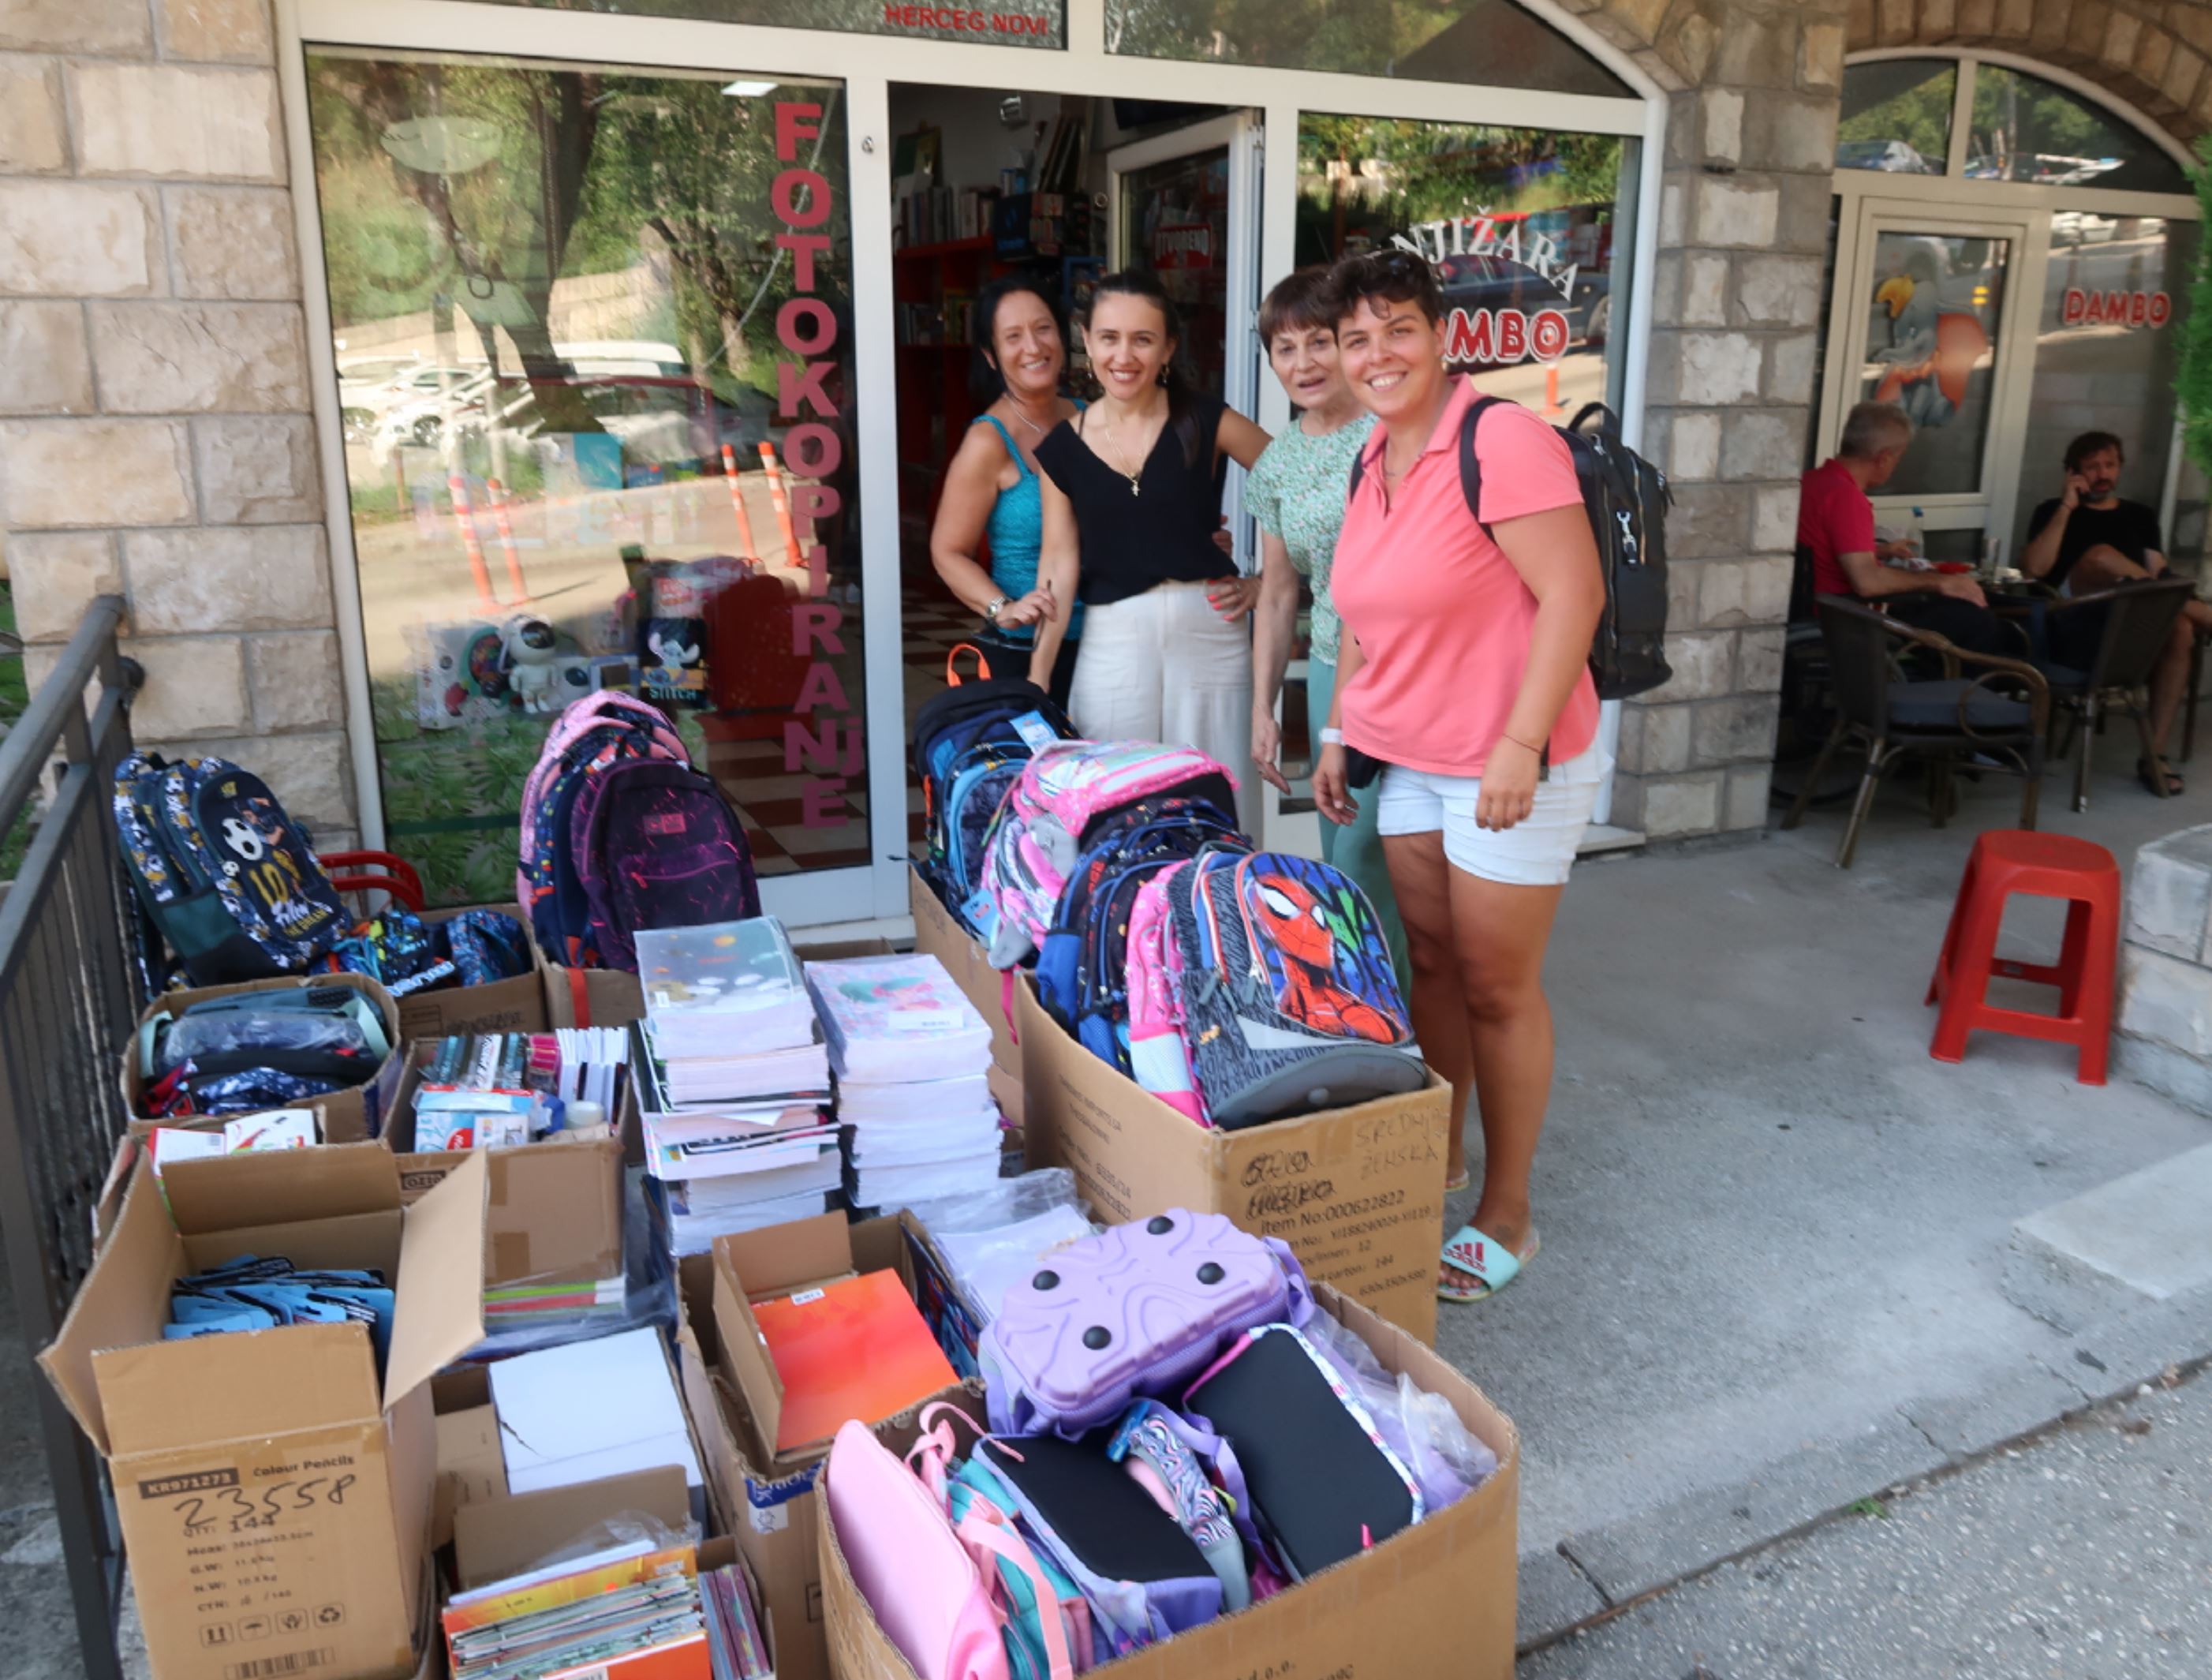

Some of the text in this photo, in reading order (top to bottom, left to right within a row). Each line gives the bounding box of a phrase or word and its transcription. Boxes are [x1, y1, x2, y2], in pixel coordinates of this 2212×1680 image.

[884, 4, 1048, 36] HERCEG NOVI
[1390, 204, 1579, 301] NJIŽARA
[2064, 288, 2171, 328] DAMBO
[1443, 308, 1571, 364] MBO
[649, 687, 697, 701] STITCH
[253, 1455, 354, 1477] Colour Pencils
[174, 1474, 356, 1528] 23558
[230, 1513, 275, 1532] 144
